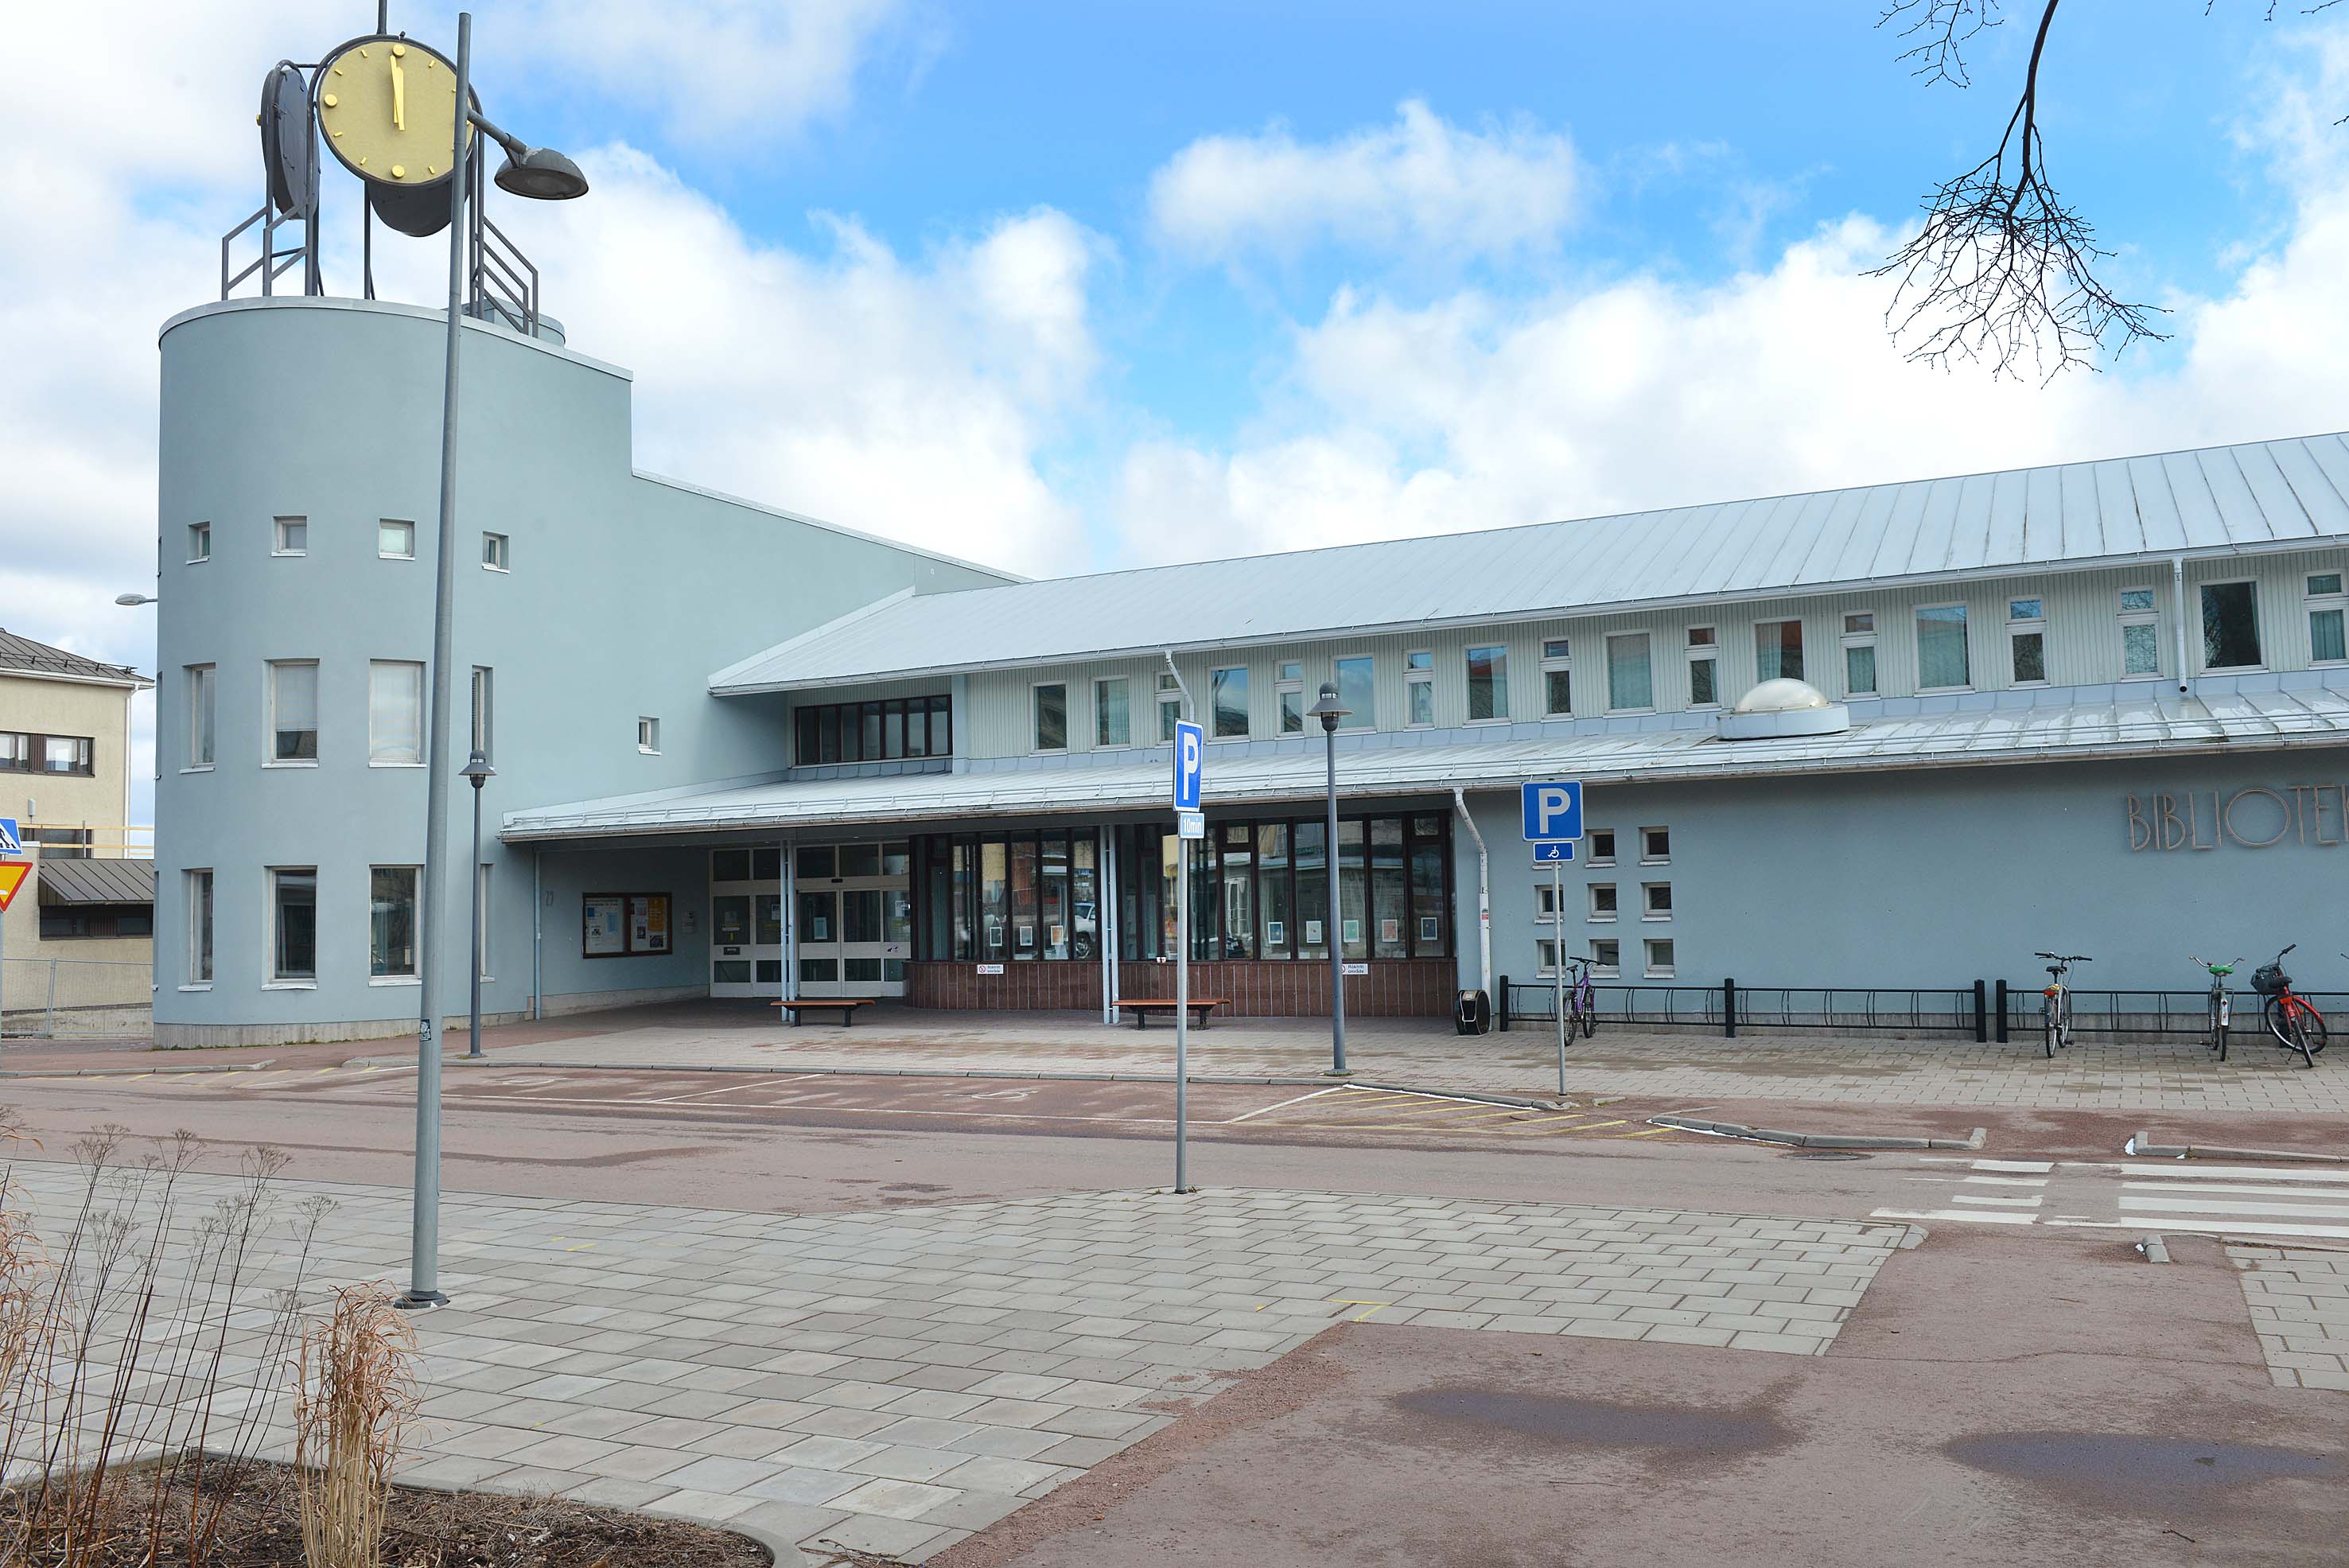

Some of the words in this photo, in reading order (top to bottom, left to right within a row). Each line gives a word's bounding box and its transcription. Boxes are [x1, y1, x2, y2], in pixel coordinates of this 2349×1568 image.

[1184, 732, 1199, 800] P
[1184, 817, 1202, 834] 10min
[1538, 788, 1571, 834] P
